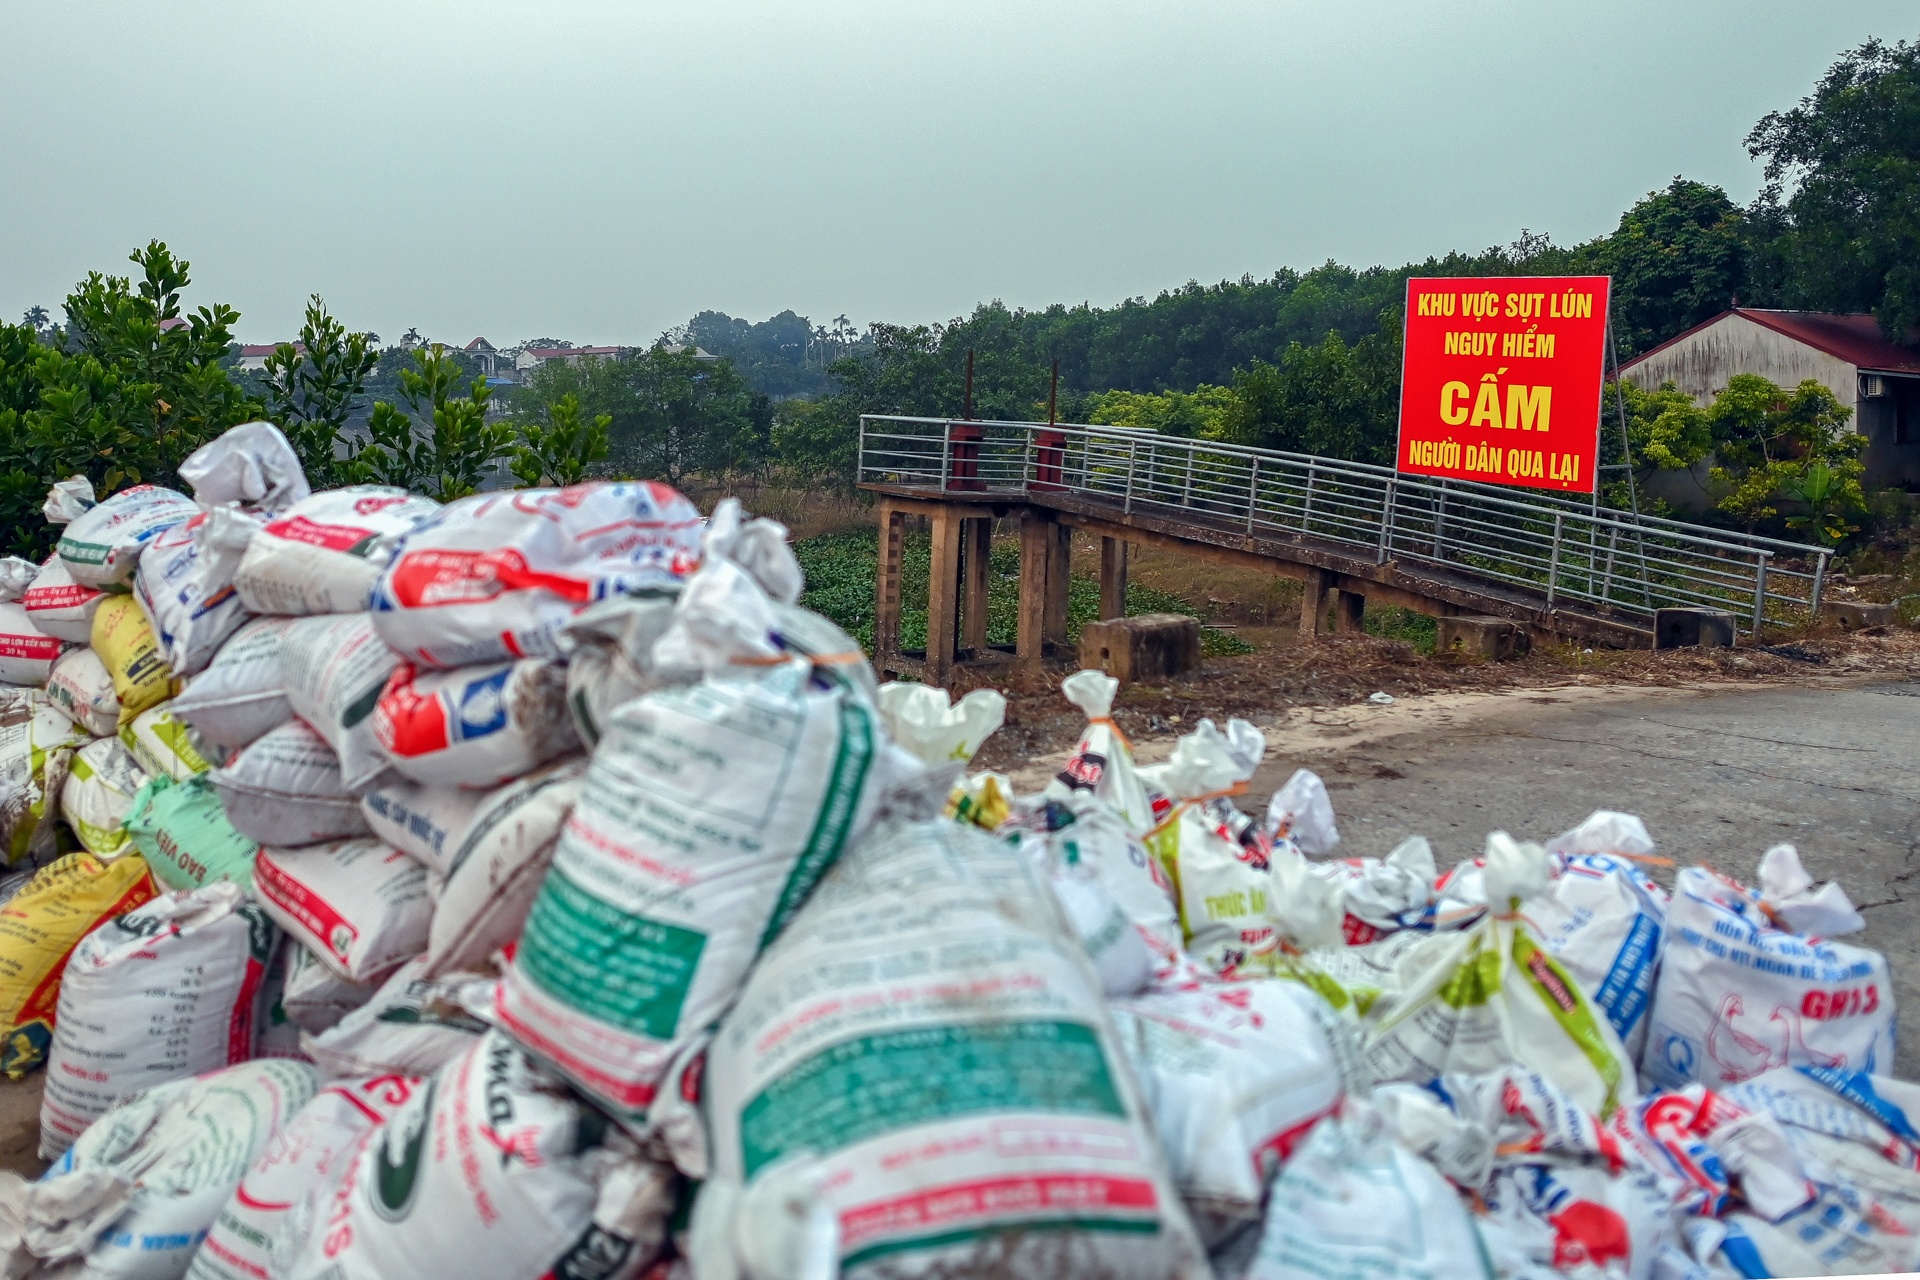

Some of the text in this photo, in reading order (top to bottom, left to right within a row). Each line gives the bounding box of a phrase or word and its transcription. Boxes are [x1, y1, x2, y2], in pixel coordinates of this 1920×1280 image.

[1418, 288, 1593, 323] KHU VỰC SỤT LÚN
[1444, 323, 1556, 358] NGUY HIỂM
[1440, 367, 1553, 432] CẤM
[1409, 436, 1580, 487] NGƯỜI DÂN QUA LẠI
[176, 850, 209, 884] SAO
